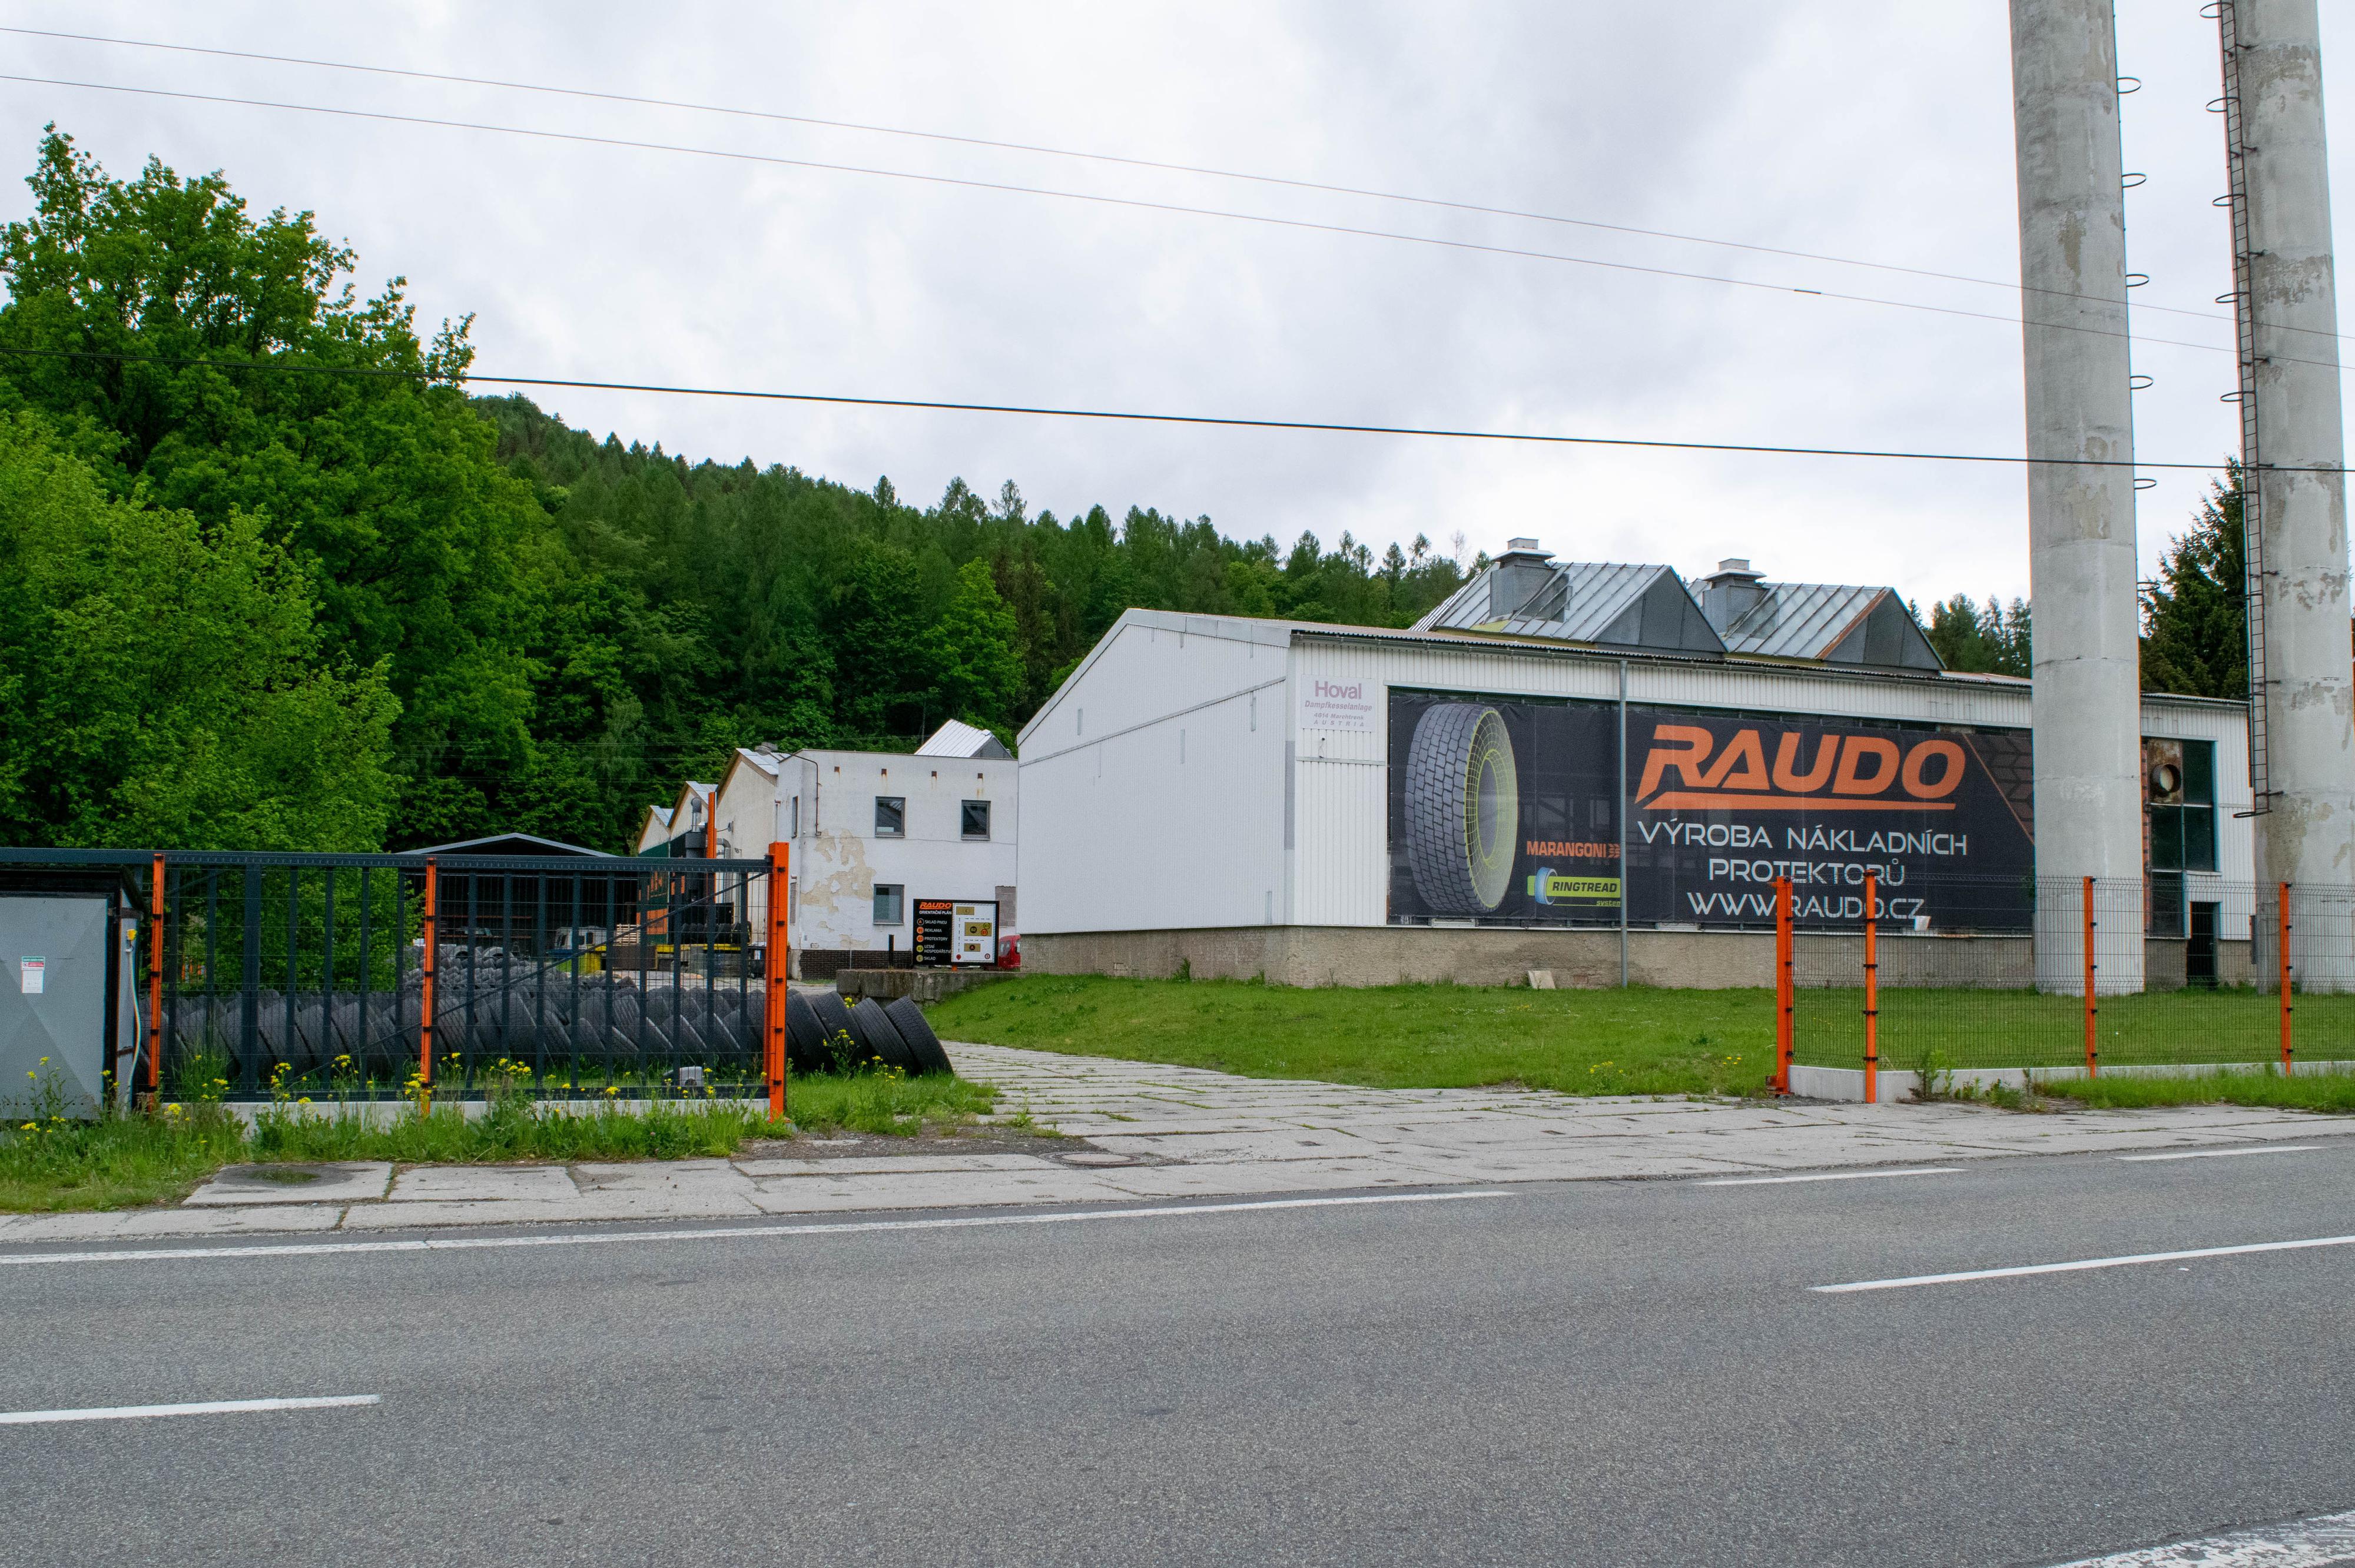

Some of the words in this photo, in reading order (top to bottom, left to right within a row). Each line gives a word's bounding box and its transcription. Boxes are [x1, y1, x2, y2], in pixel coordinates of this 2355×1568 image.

[1315, 680, 1362, 700] Hoval
[1305, 700, 1372, 712] Dampfkesselanlage
[1635, 725, 1966, 805] RAUDO
[1637, 818, 1773, 848] VÝROBA
[1787, 825, 1967, 855] NÁKLADNÍCH
[1527, 841, 1606, 858] MARANGONI
[1709, 858, 1905, 886] PROTEKTORŮ
[1553, 882, 1617, 892] RINGTREAD
[1686, 892, 1925, 919] WWWRAUDO.CZ
